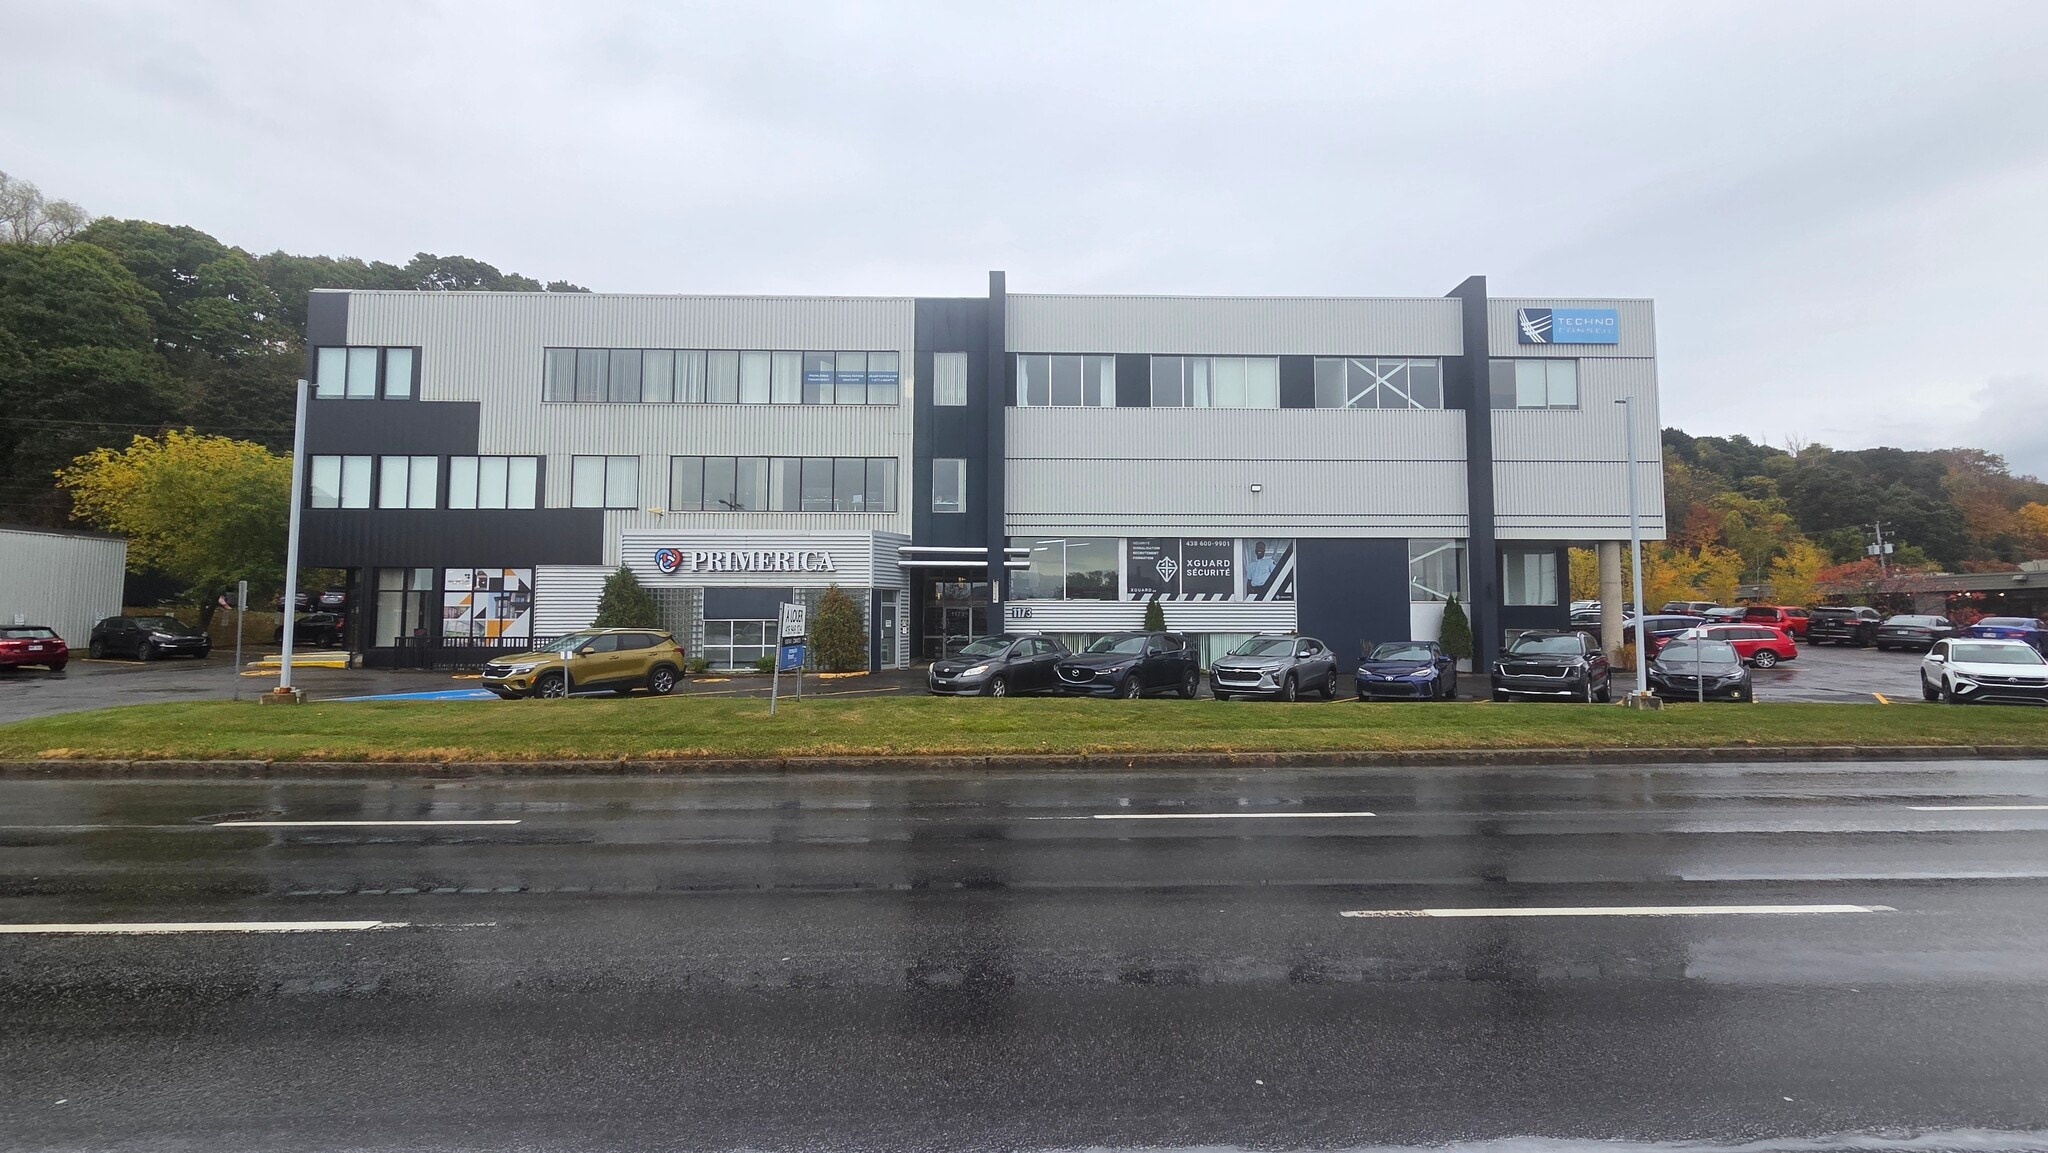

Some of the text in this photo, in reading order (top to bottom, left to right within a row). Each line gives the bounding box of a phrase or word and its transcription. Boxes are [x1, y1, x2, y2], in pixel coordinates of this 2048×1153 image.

[1558, 317, 1614, 326] TECHNO
[690, 550, 836, 573] PRIMERICA
[1186, 559, 1231, 567] XGUARD
[1186, 568, 1231, 577] SÉCURITÉ
[1012, 607, 1033, 618] 1173
